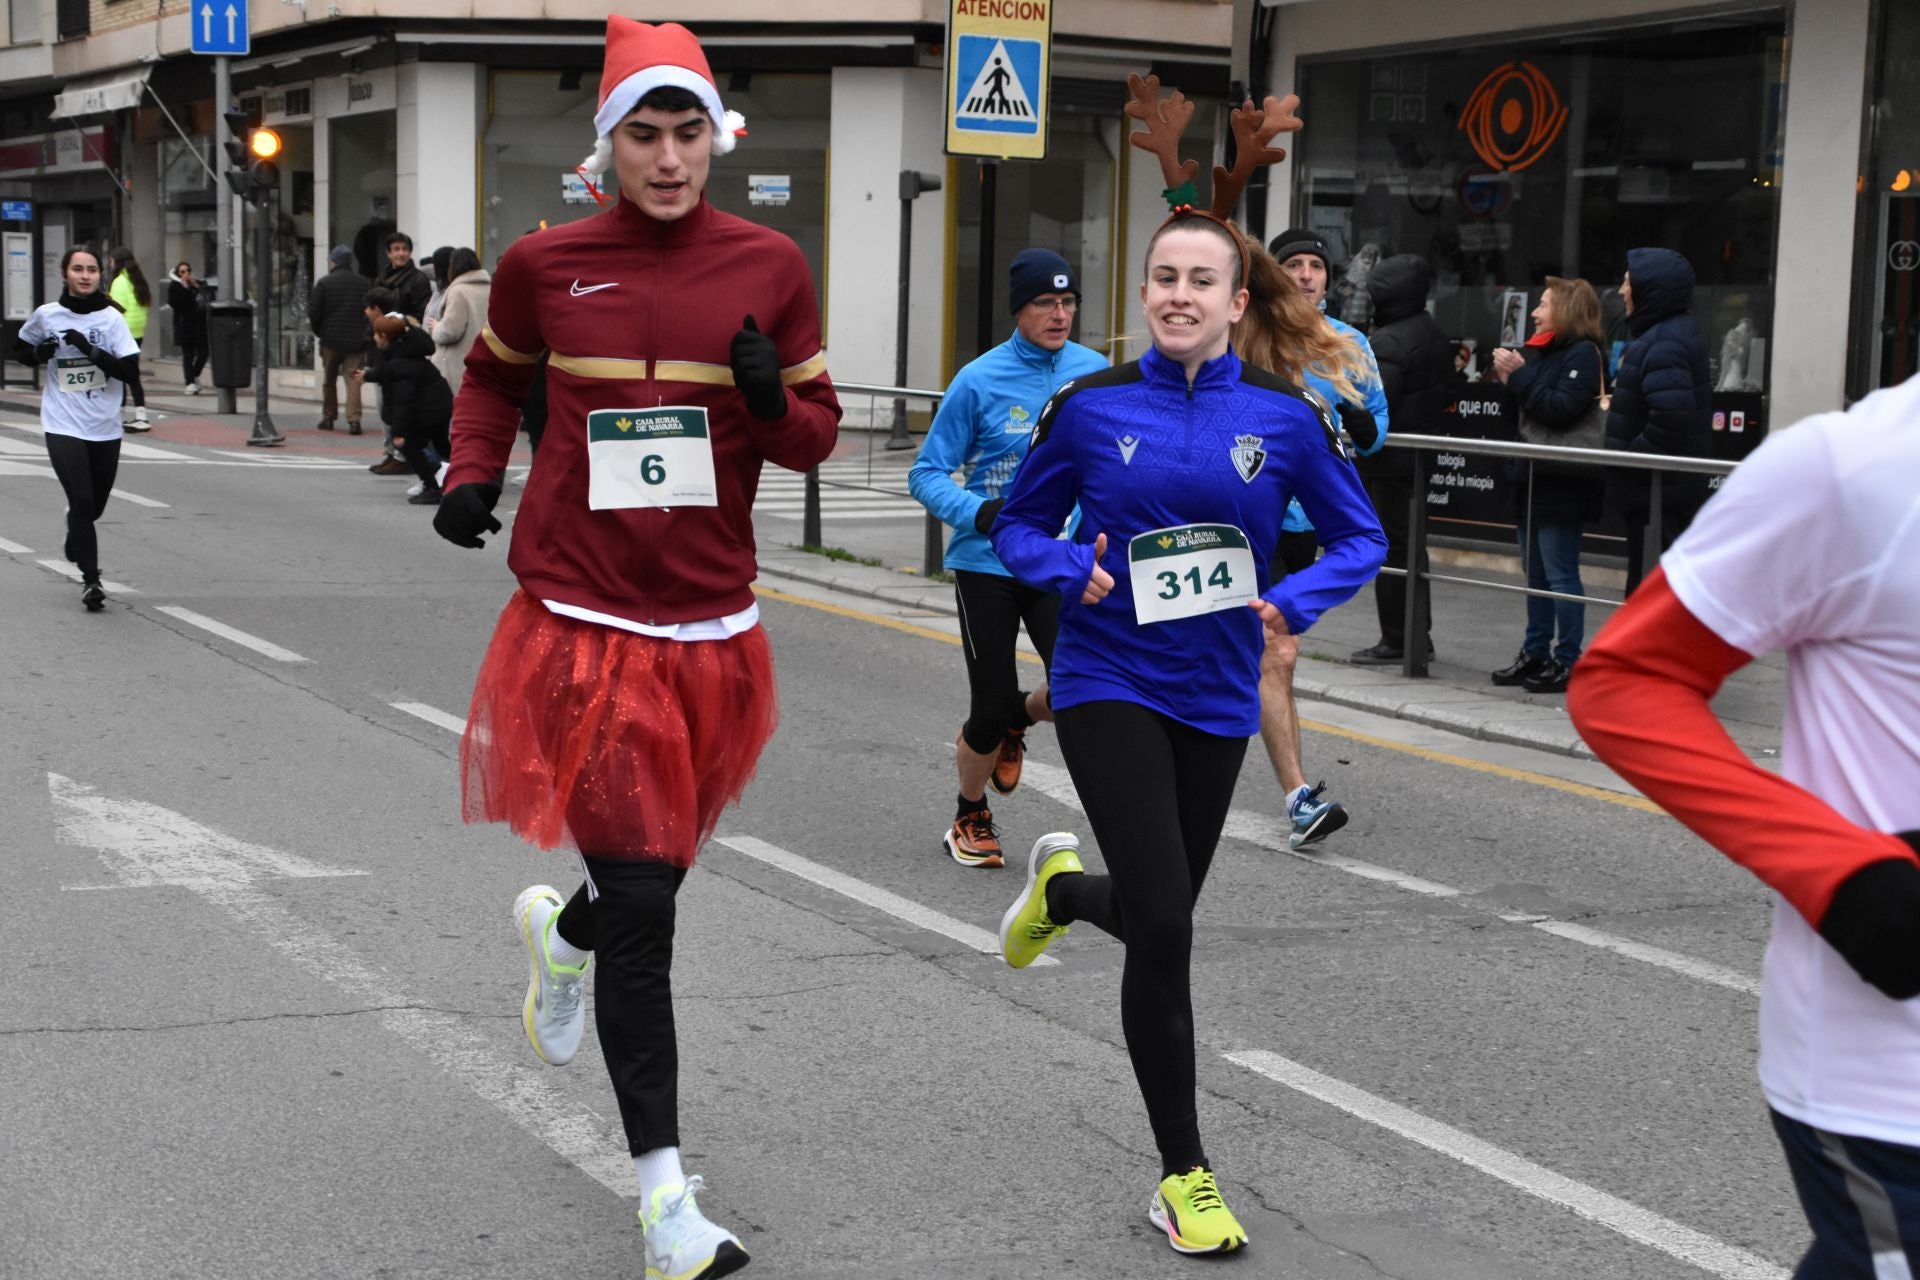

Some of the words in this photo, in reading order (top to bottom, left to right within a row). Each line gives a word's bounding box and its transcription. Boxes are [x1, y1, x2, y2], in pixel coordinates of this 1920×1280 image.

[956, 0, 1045, 21] ATENCION
[66, 371, 96, 385] 267
[1459, 400, 1481, 417] que
[635, 418, 653, 426] CAJA
[655, 416, 680, 425] RURAL
[648, 423, 684, 432] NAVARRA
[1437, 453, 1465, 469] tología
[640, 455, 666, 485] 6
[1445, 472, 1457, 486] de
[1457, 472, 1466, 487] la
[1466, 475, 1494, 491] miopía
[1189, 536, 1222, 546] NAVARRA
[1156, 561, 1233, 601] 314
